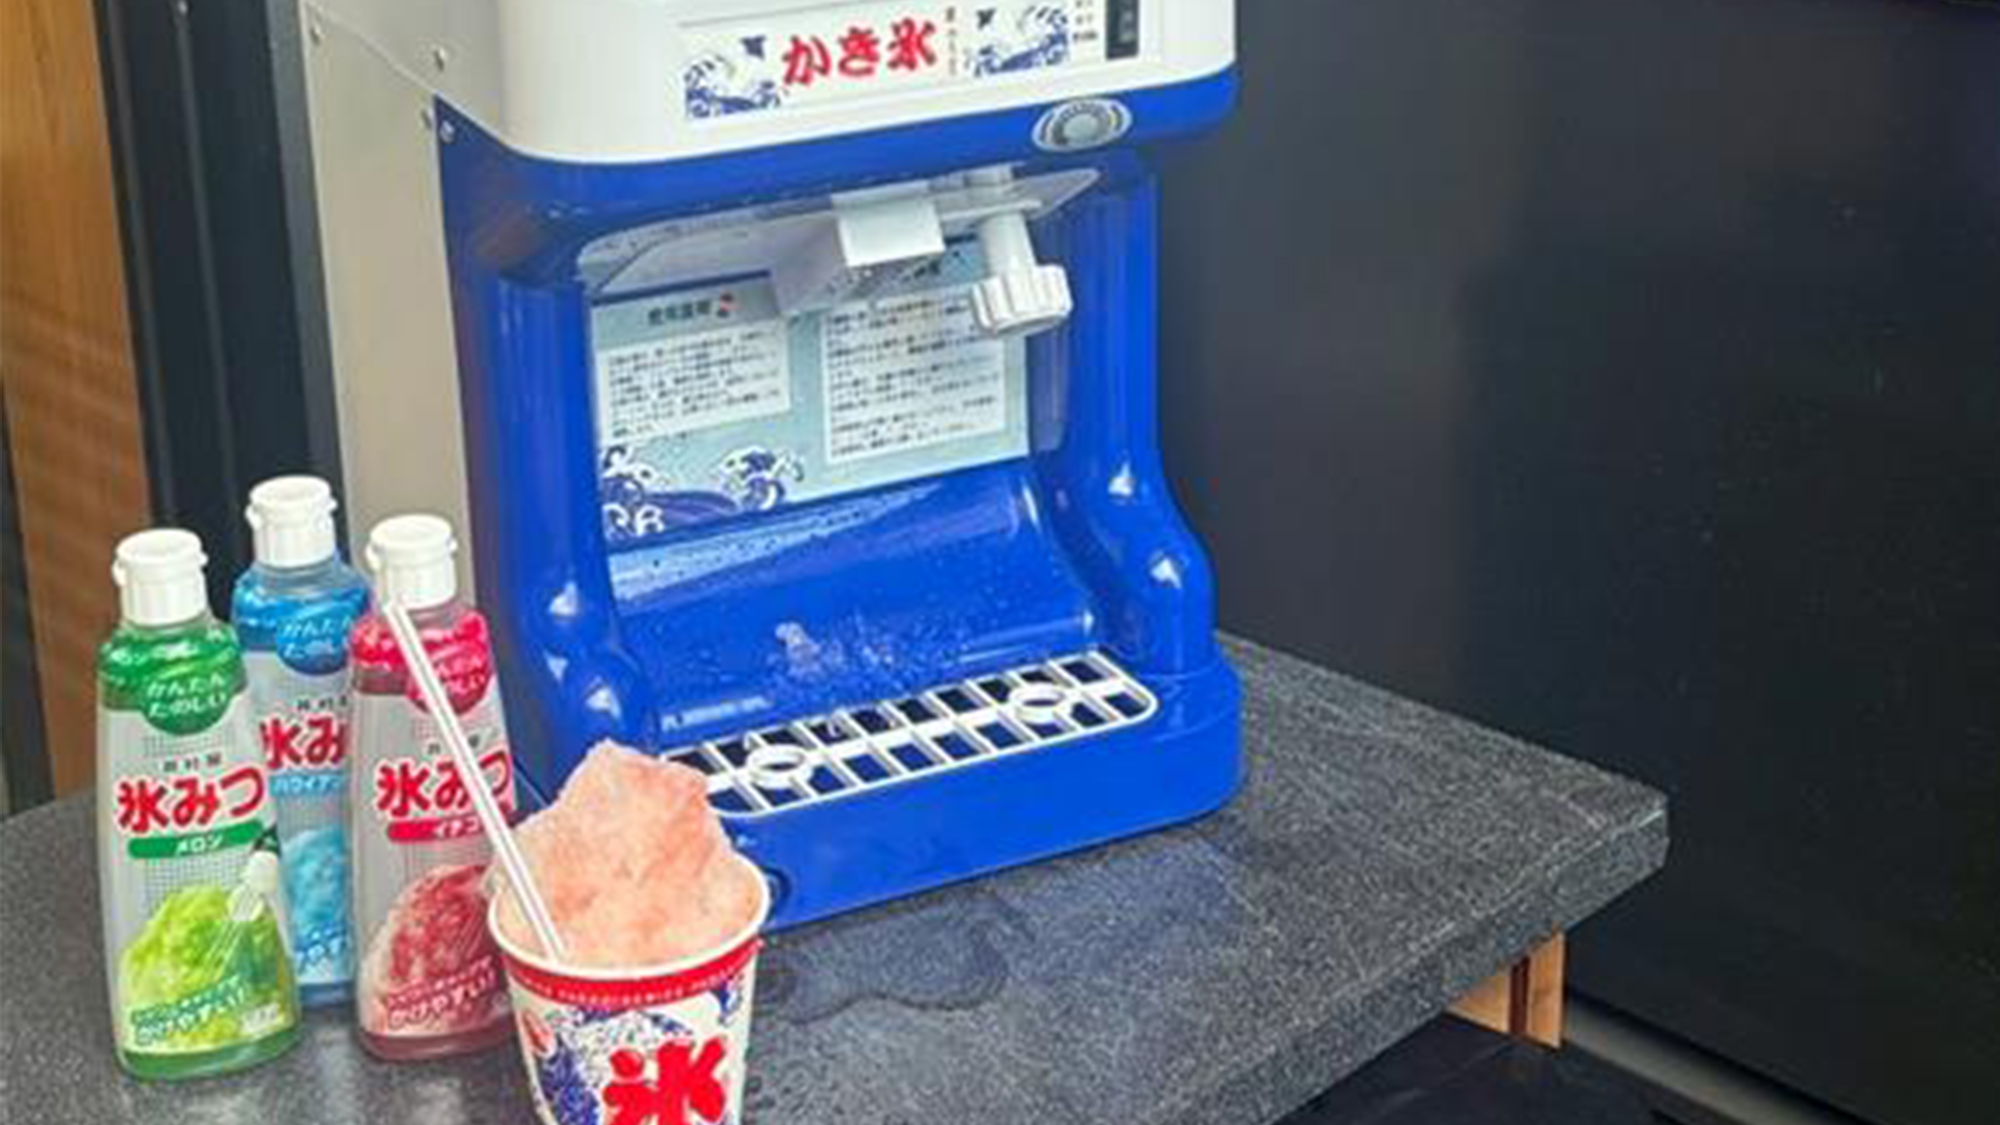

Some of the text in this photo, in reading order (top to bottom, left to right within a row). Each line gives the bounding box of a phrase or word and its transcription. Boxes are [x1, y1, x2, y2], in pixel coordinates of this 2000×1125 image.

[781, 16, 938, 86] かき氷
[147, 672, 226, 698] かんたん
[117, 767, 265, 832] 氷みつ
[377, 751, 511, 817] 氷みつ
[176, 835, 223, 853] メロン
